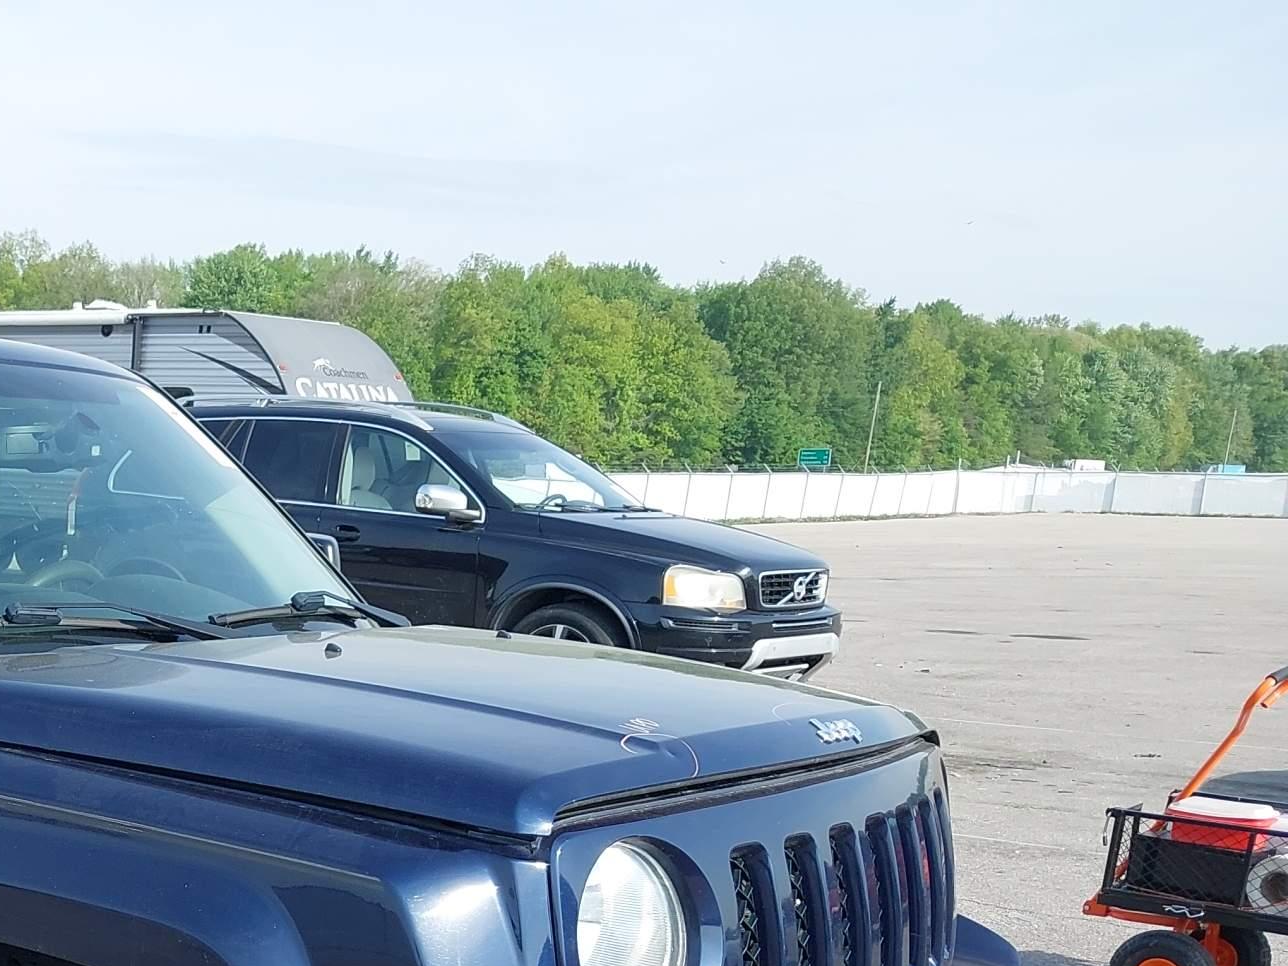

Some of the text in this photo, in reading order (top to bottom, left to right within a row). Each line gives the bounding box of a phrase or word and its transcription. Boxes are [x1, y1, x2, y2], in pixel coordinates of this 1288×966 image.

[322, 366, 369, 380] Coachmen
[295, 377, 399, 402] CATALINA
[808, 718, 863, 744] Jeep
